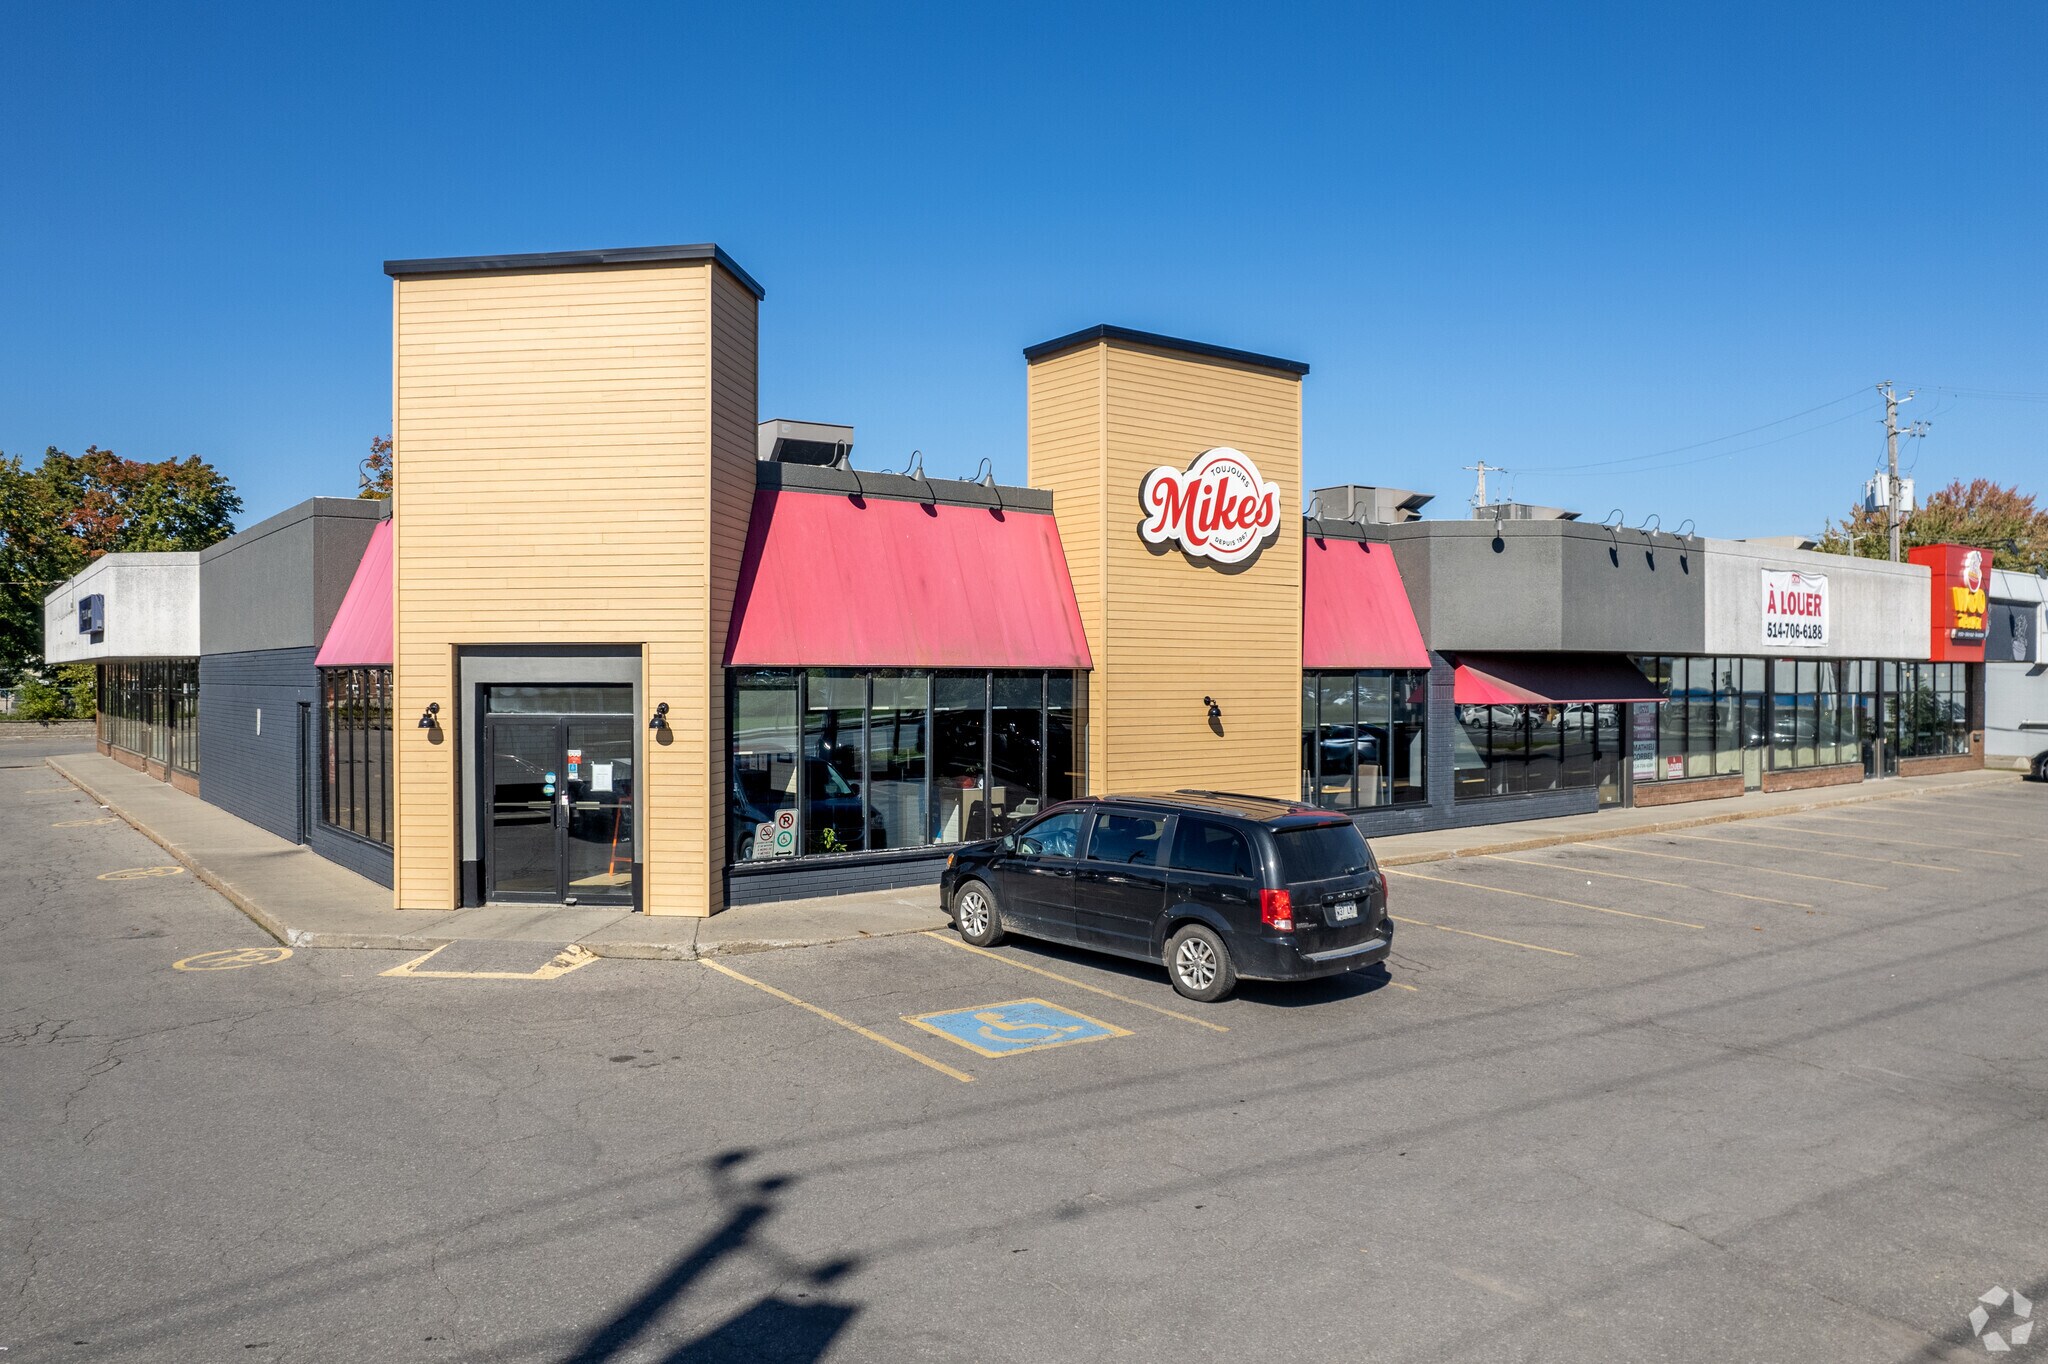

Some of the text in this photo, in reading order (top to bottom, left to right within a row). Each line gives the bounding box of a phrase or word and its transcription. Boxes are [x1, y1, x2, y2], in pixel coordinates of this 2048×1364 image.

[1210, 465, 1250, 488] TOUJOURS
[1151, 476, 1273, 546] Mikes
[1214, 536, 1236, 547] DEPUIS
[1767, 582, 1822, 617] À LOUER
[1767, 621, 1823, 640] 514-706-6188
